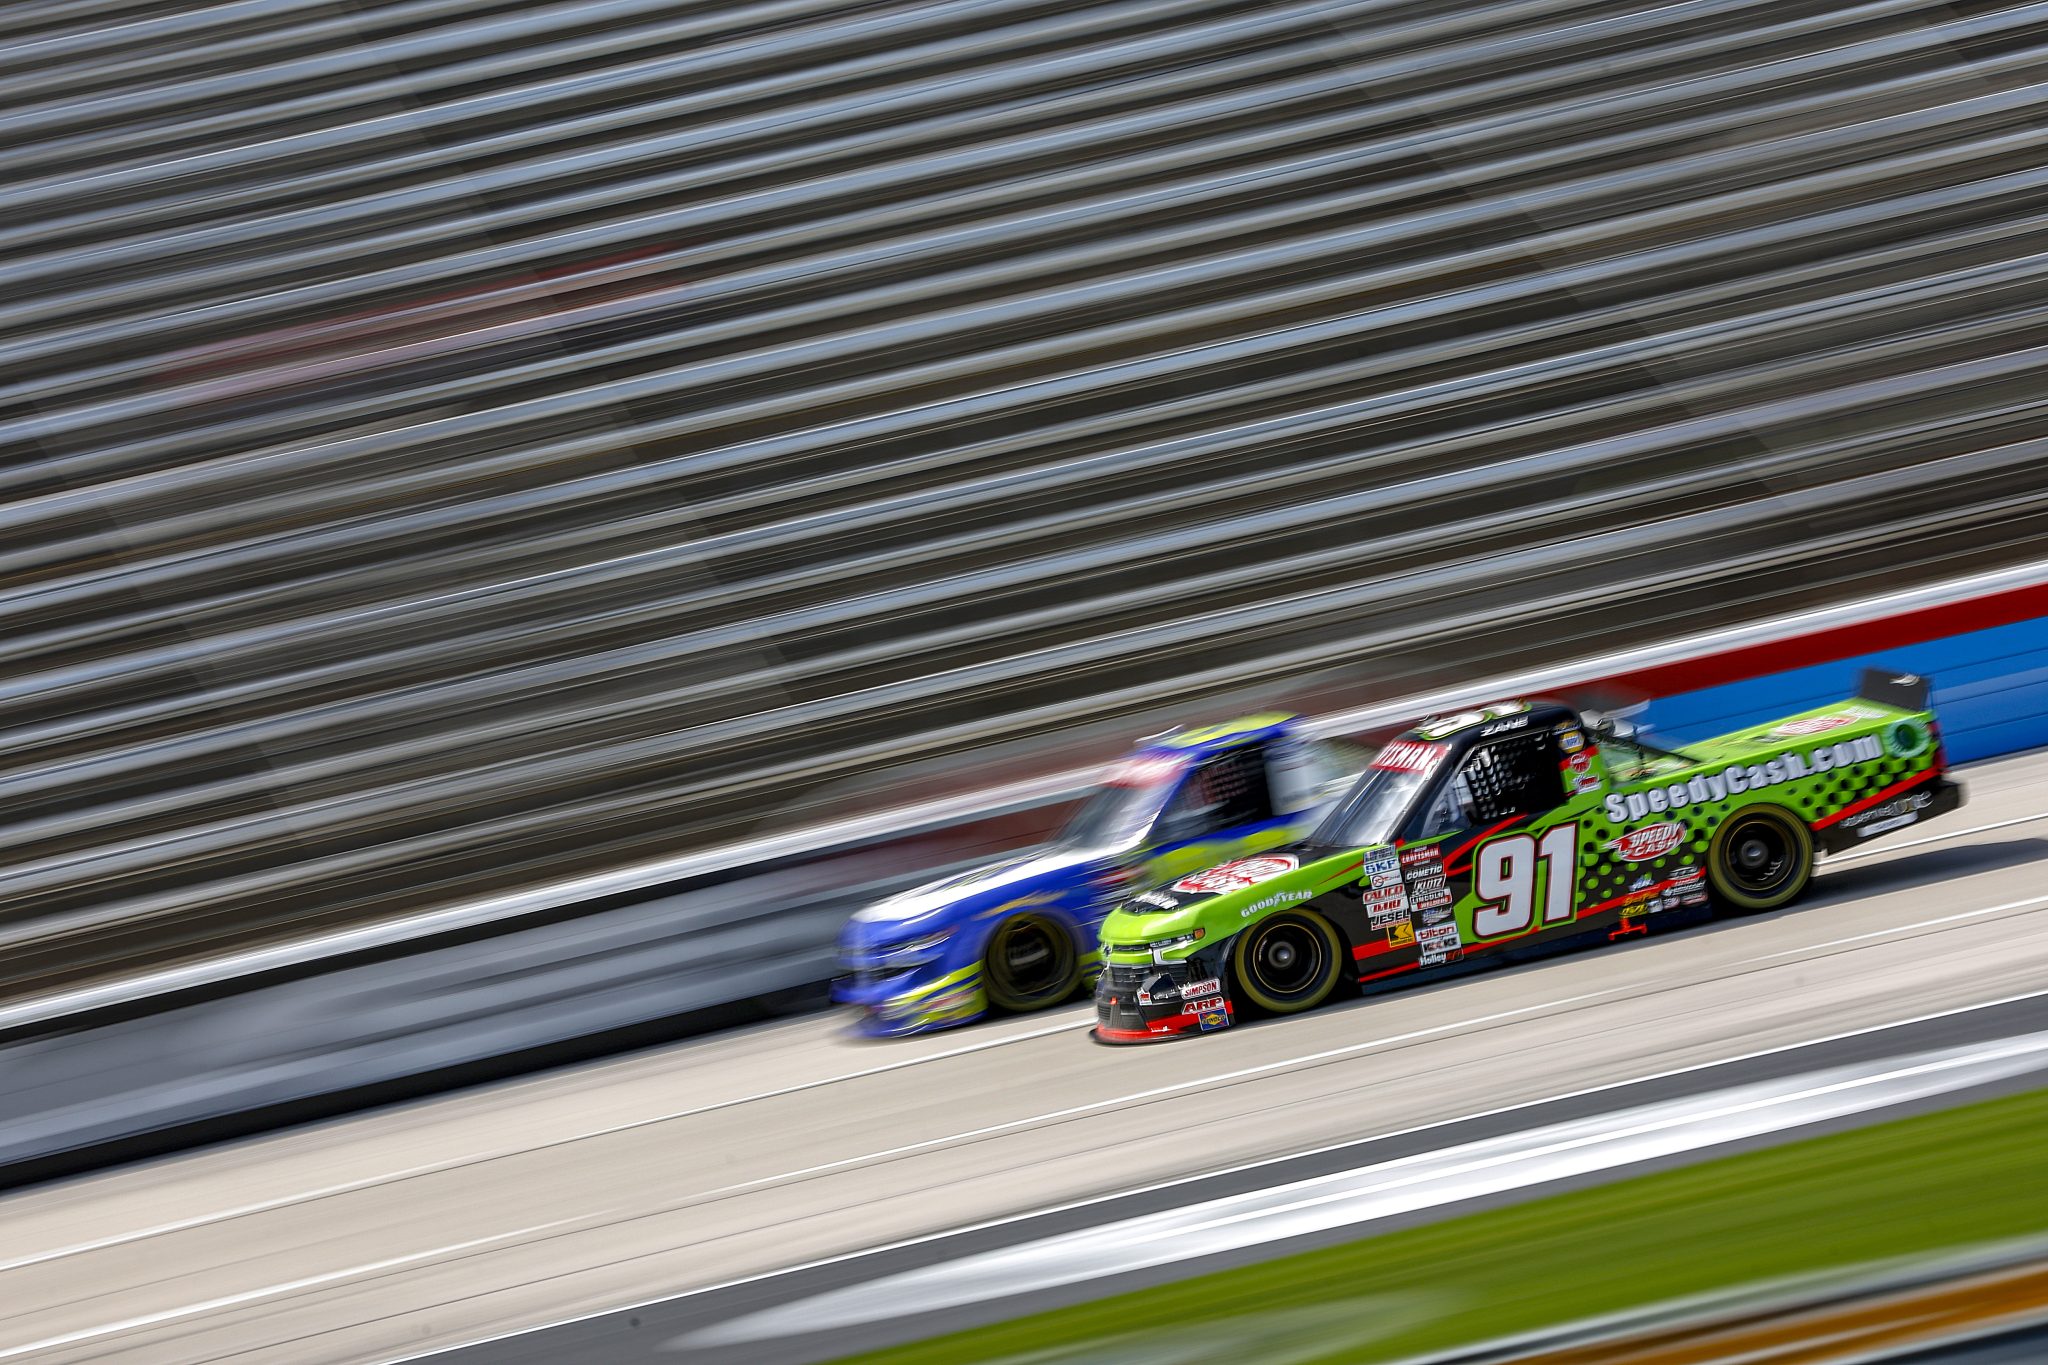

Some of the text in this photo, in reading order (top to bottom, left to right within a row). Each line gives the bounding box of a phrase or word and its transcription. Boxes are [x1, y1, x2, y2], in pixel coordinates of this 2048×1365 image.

[1604, 733, 1884, 823] SpeedyCash.com
[1630, 823, 1681, 849] SPEEDY
[1635, 836, 1678, 857] CASH
[1366, 861, 1396, 875] SKF
[1406, 864, 1443, 880] COMETIC
[1416, 877, 1442, 890] KLOTZ
[1473, 822, 1578, 938] 91
[1364, 885, 1403, 901] CALICO
[1412, 891, 1444, 904] LINCOLN
[1240, 890, 1313, 918] GOODYEAR
[1372, 909, 1410, 925] JESEL
[1419, 926, 1454, 938] tilton
[1420, 952, 1446, 965] Holley
[1184, 981, 1217, 997] SIMPSON
[1183, 998, 1224, 1013] ARP
